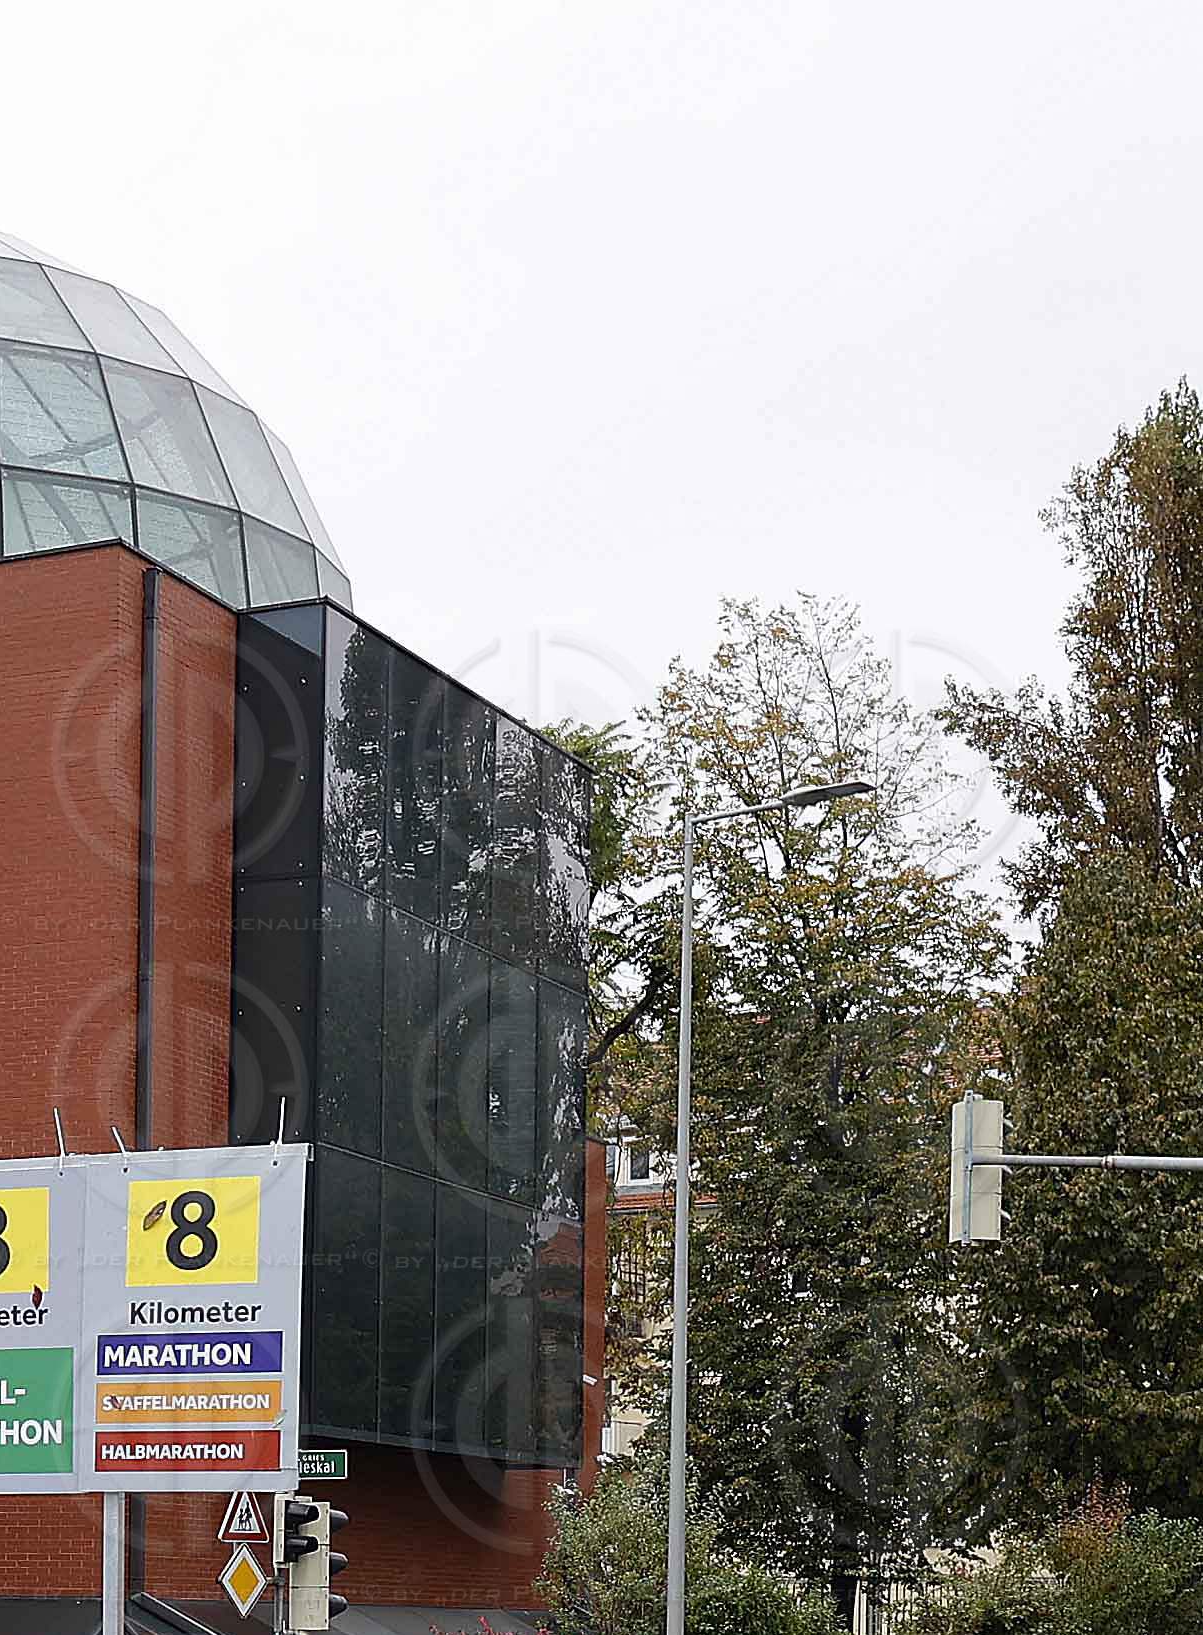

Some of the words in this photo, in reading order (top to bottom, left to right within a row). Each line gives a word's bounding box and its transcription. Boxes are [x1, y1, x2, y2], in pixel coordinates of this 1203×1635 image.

[165, 1190, 218, 1271] 8
[129, 1300, 262, 1325] Kilometer
[103, 1342, 252, 1368] MARATHON
[100, 1443, 245, 1461] HALBMARATHON
